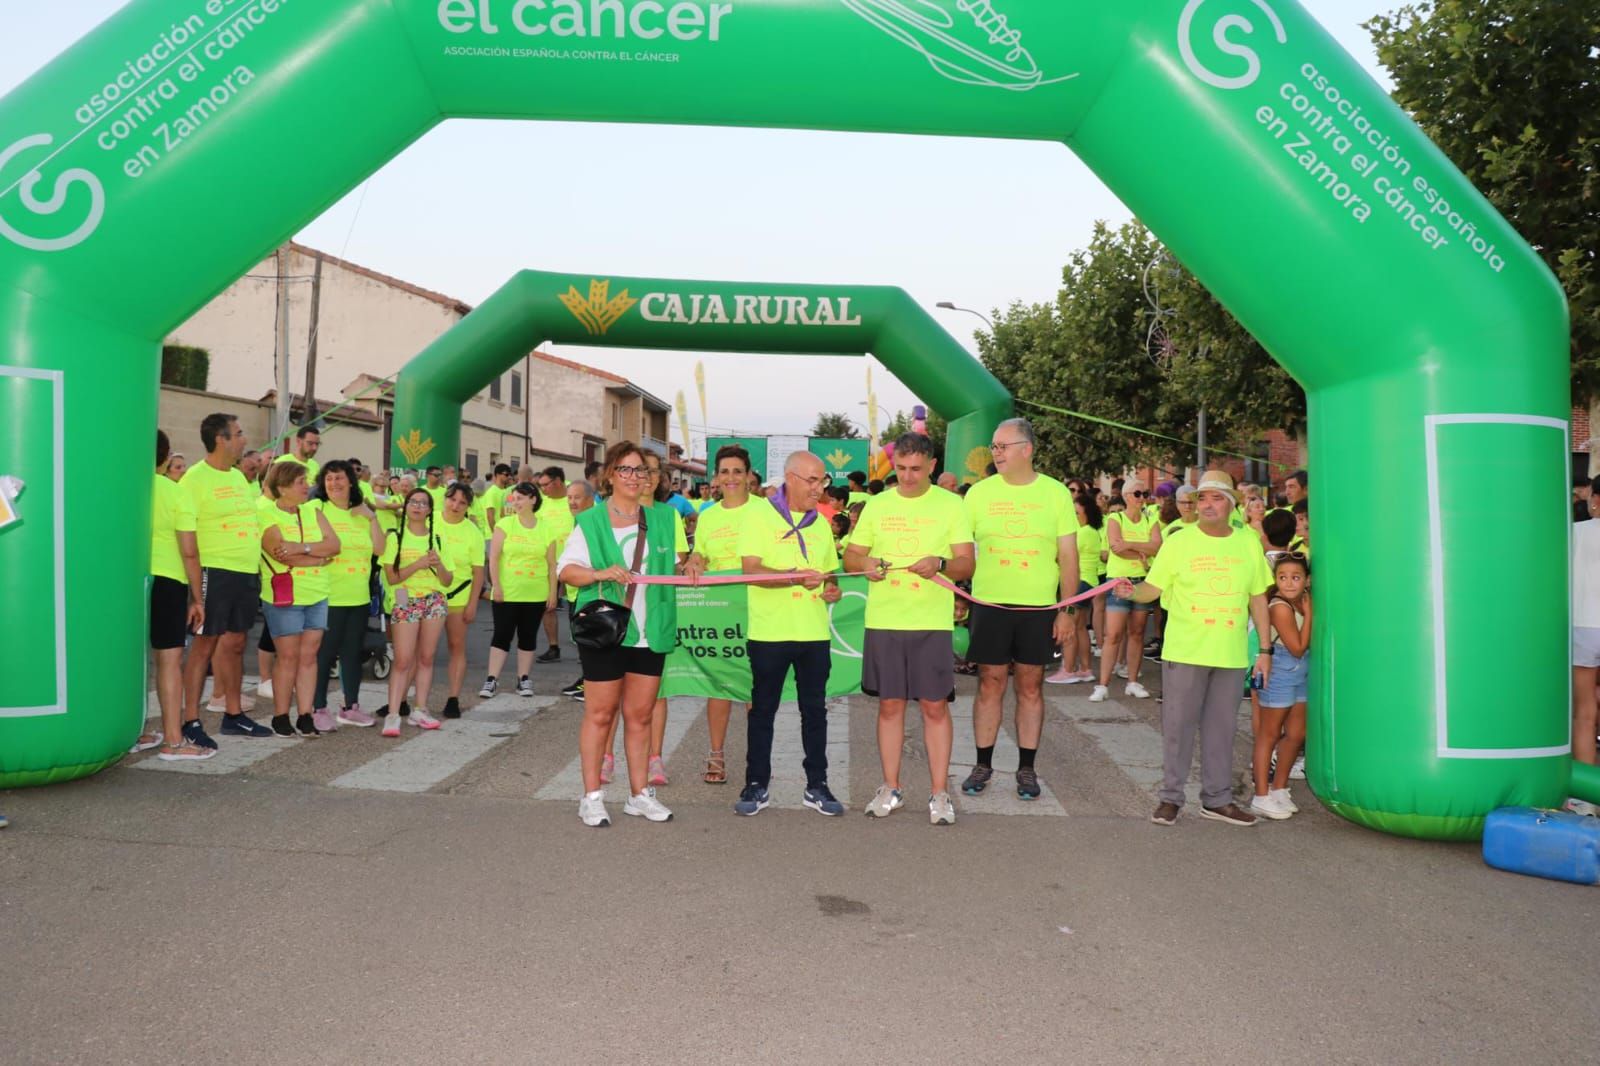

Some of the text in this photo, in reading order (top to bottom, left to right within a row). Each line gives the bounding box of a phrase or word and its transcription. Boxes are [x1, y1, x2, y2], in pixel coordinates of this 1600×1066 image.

[75, 14, 204, 125] asociación
[437, 0, 499, 34] el
[444, 46, 680, 63] ASOCIACIÓN ESPAÑOLA CONTRA EL CÁNCER
[98, 0, 287, 151] contra el cánce
[123, 64, 256, 178] en Zamora
[1255, 104, 1372, 223] en Zamora
[1279, 82, 1449, 251] contra el cáncer
[1301, 62, 1506, 273] asociación española
[640, 292, 861, 326] CAJA RURAL
[723, 623, 743, 639] el
